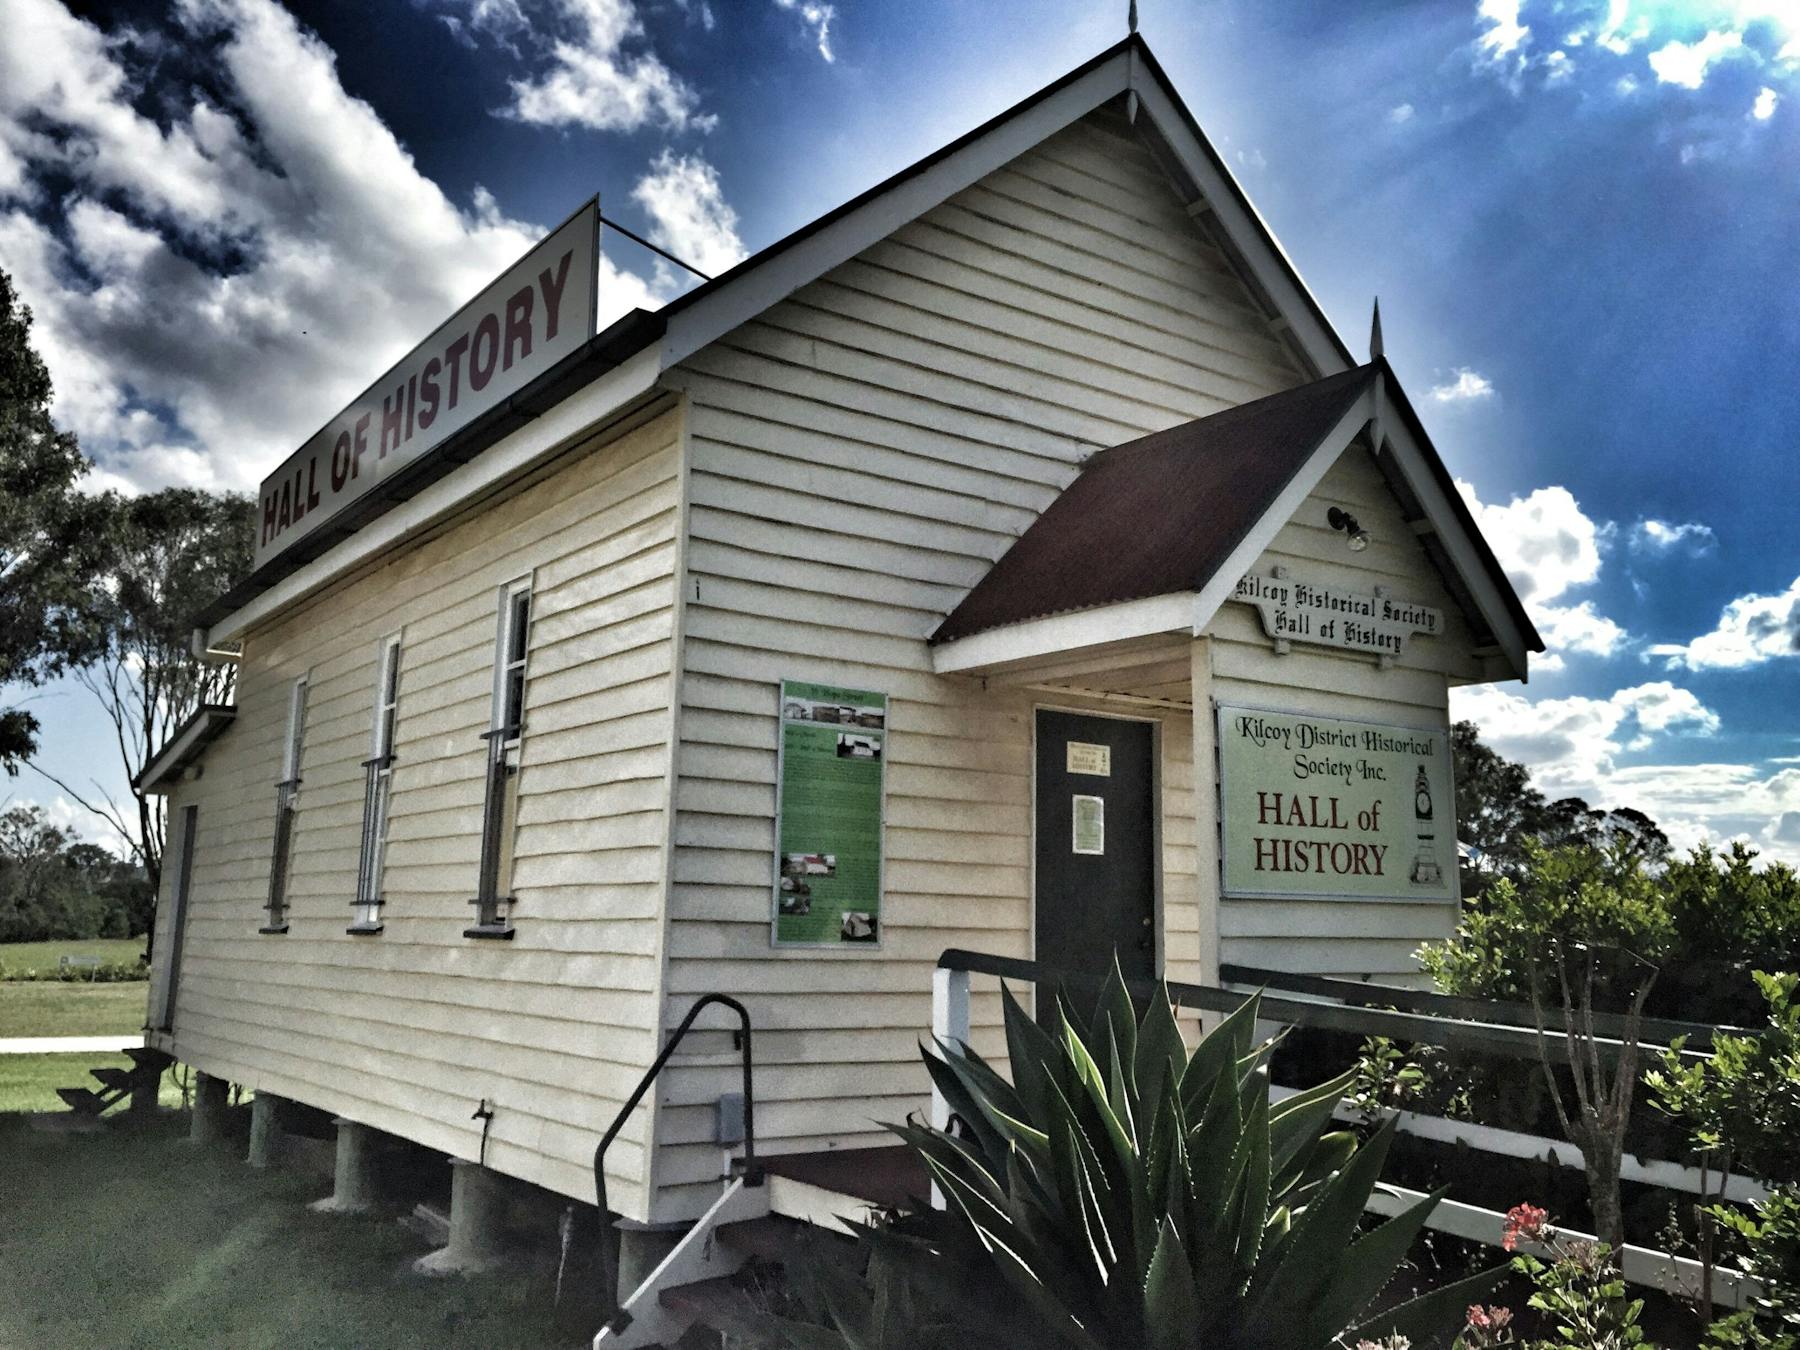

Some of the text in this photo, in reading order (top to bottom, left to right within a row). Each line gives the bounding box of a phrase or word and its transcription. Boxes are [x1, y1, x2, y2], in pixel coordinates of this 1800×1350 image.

[262, 249, 573, 547] HALL OF HISTORY
[1235, 575, 1436, 631] Kilcoy Historical Society
[1275, 610, 1401, 653] Hall of History
[1235, 716, 1434, 756] Kilcoy District Historical
[1293, 754, 1386, 786] Society Inc.
[1257, 791, 1382, 831] HALL of
[1253, 838, 1388, 876] HISTORY
